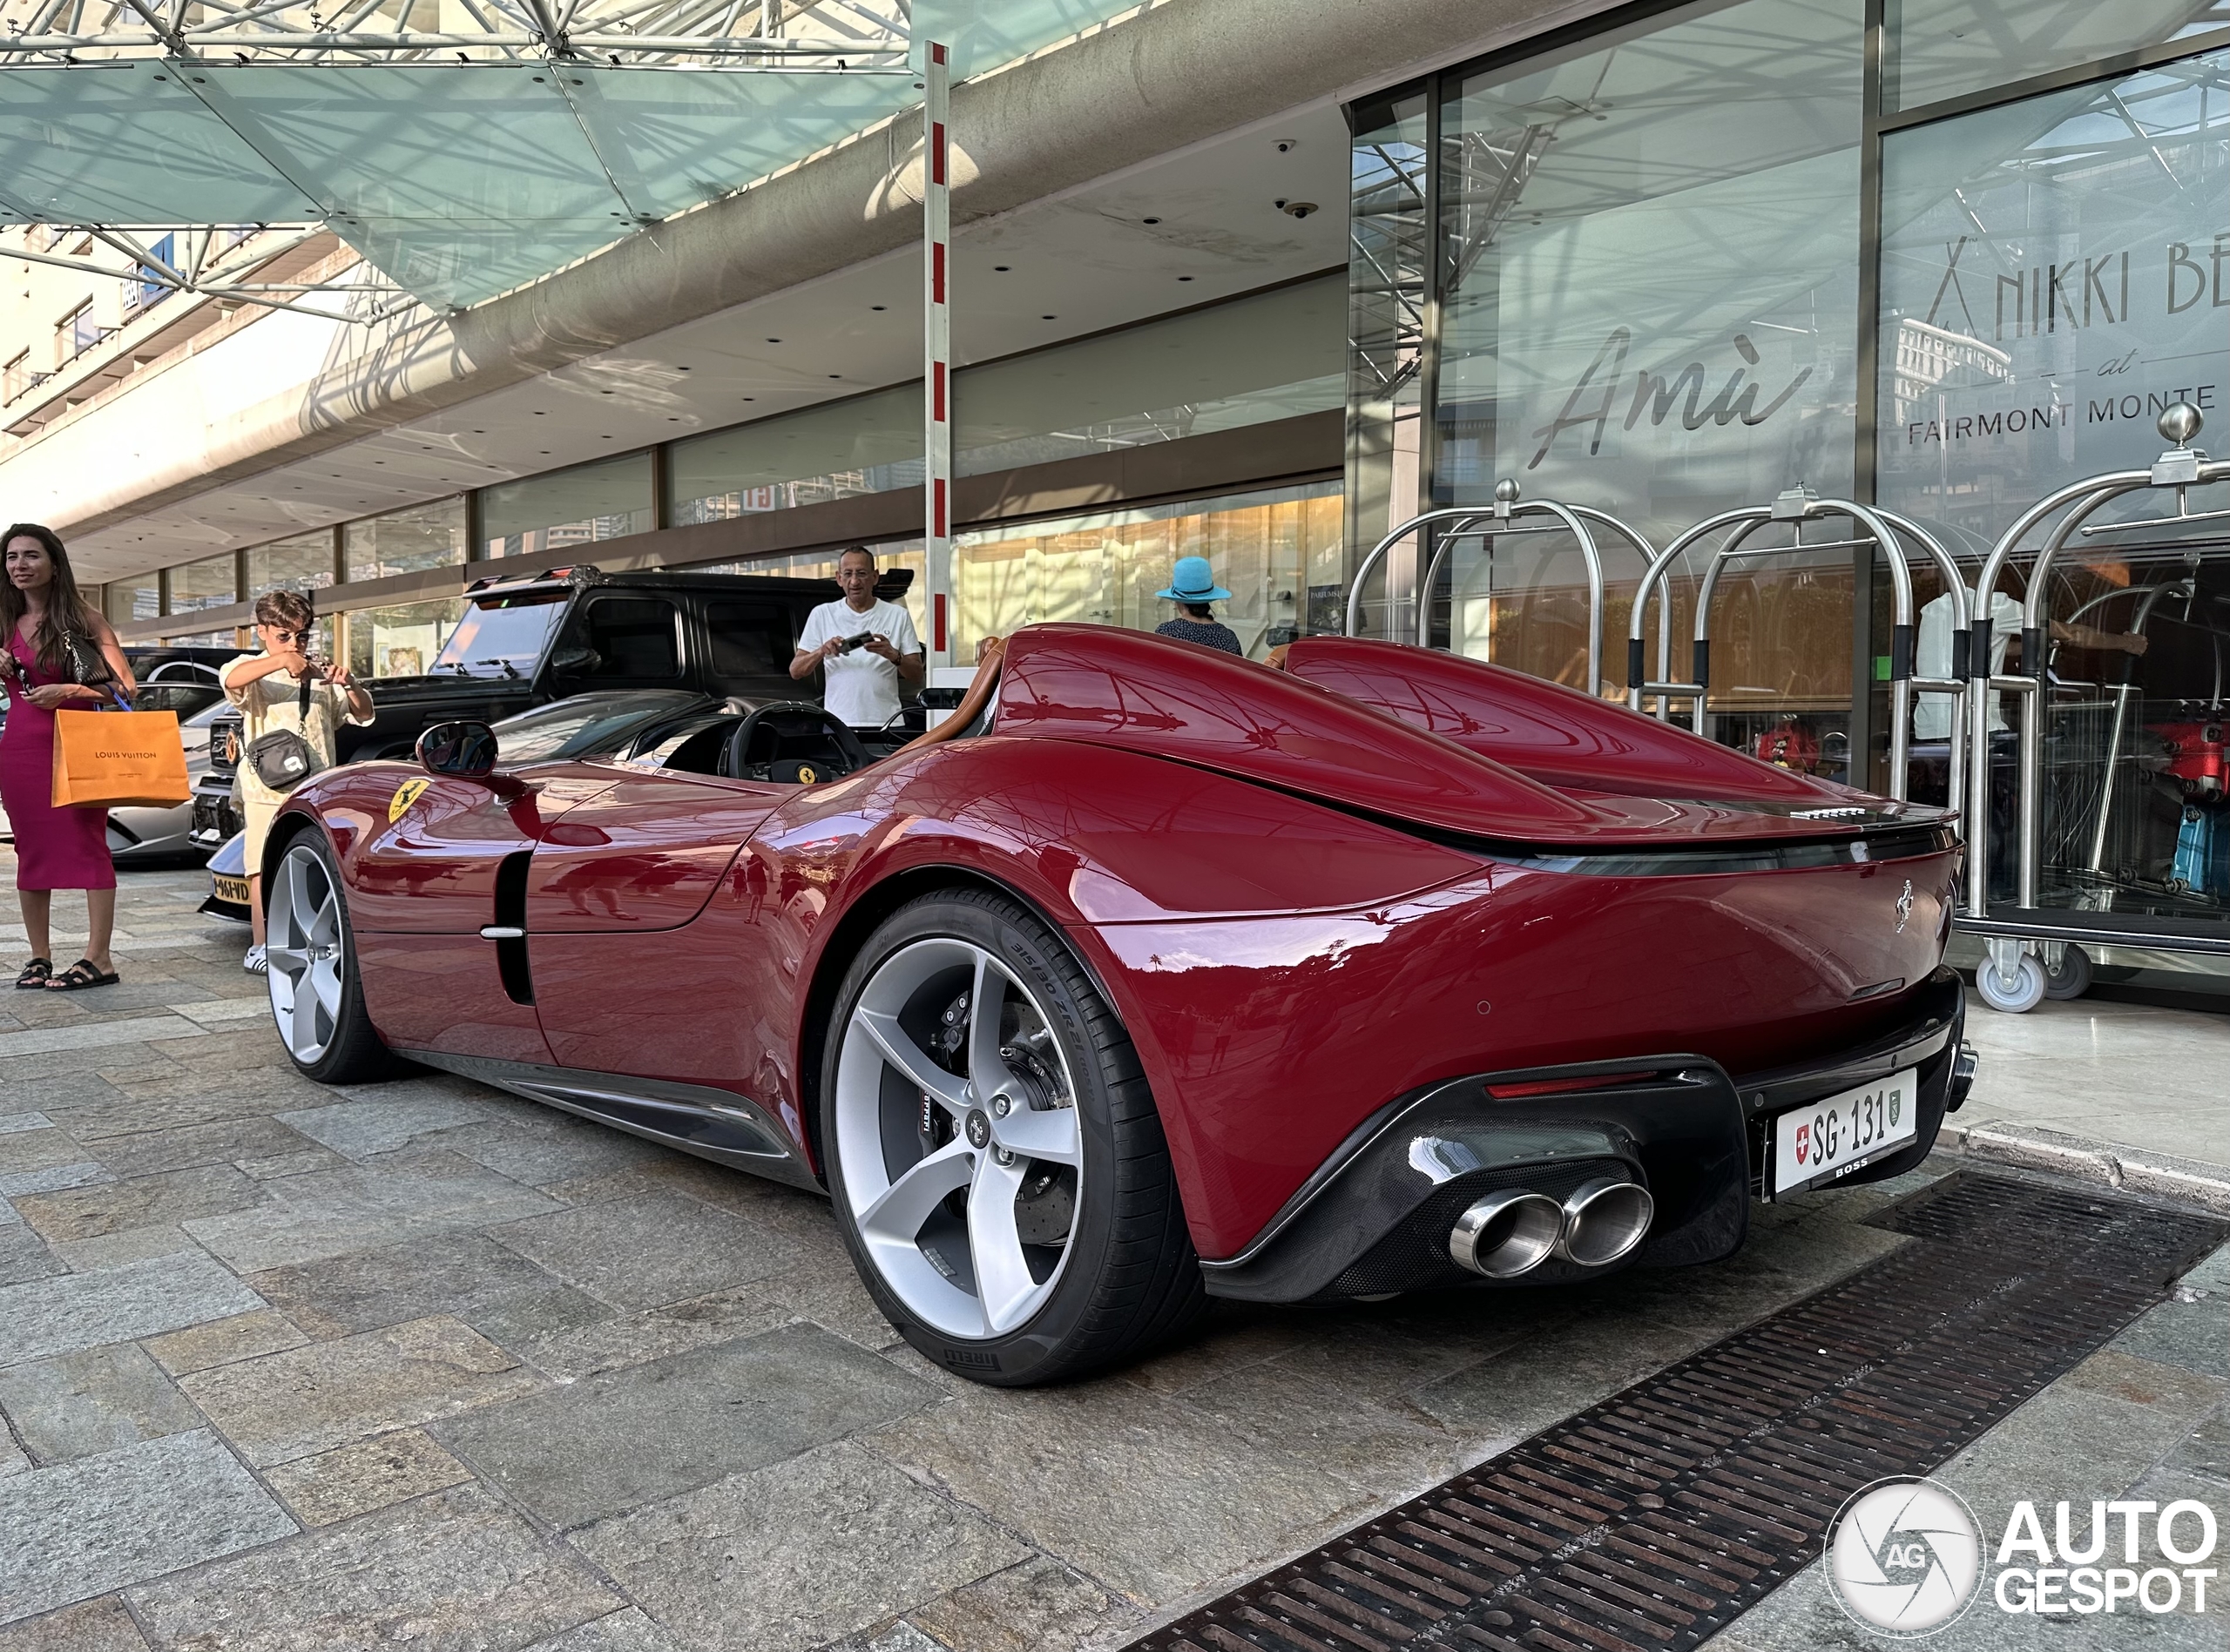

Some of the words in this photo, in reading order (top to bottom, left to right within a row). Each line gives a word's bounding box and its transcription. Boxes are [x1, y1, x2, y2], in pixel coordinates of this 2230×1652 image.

[1996, 251, 2129, 341] NIKKI
[2097, 348, 2139, 377] at
[1909, 403, 2073, 445] FAIRMONT
[1010, 942, 1057, 995] 315/30
[1835, 1157, 1868, 1178] BOSS
[943, 1349, 1003, 1372] PIRELLI
